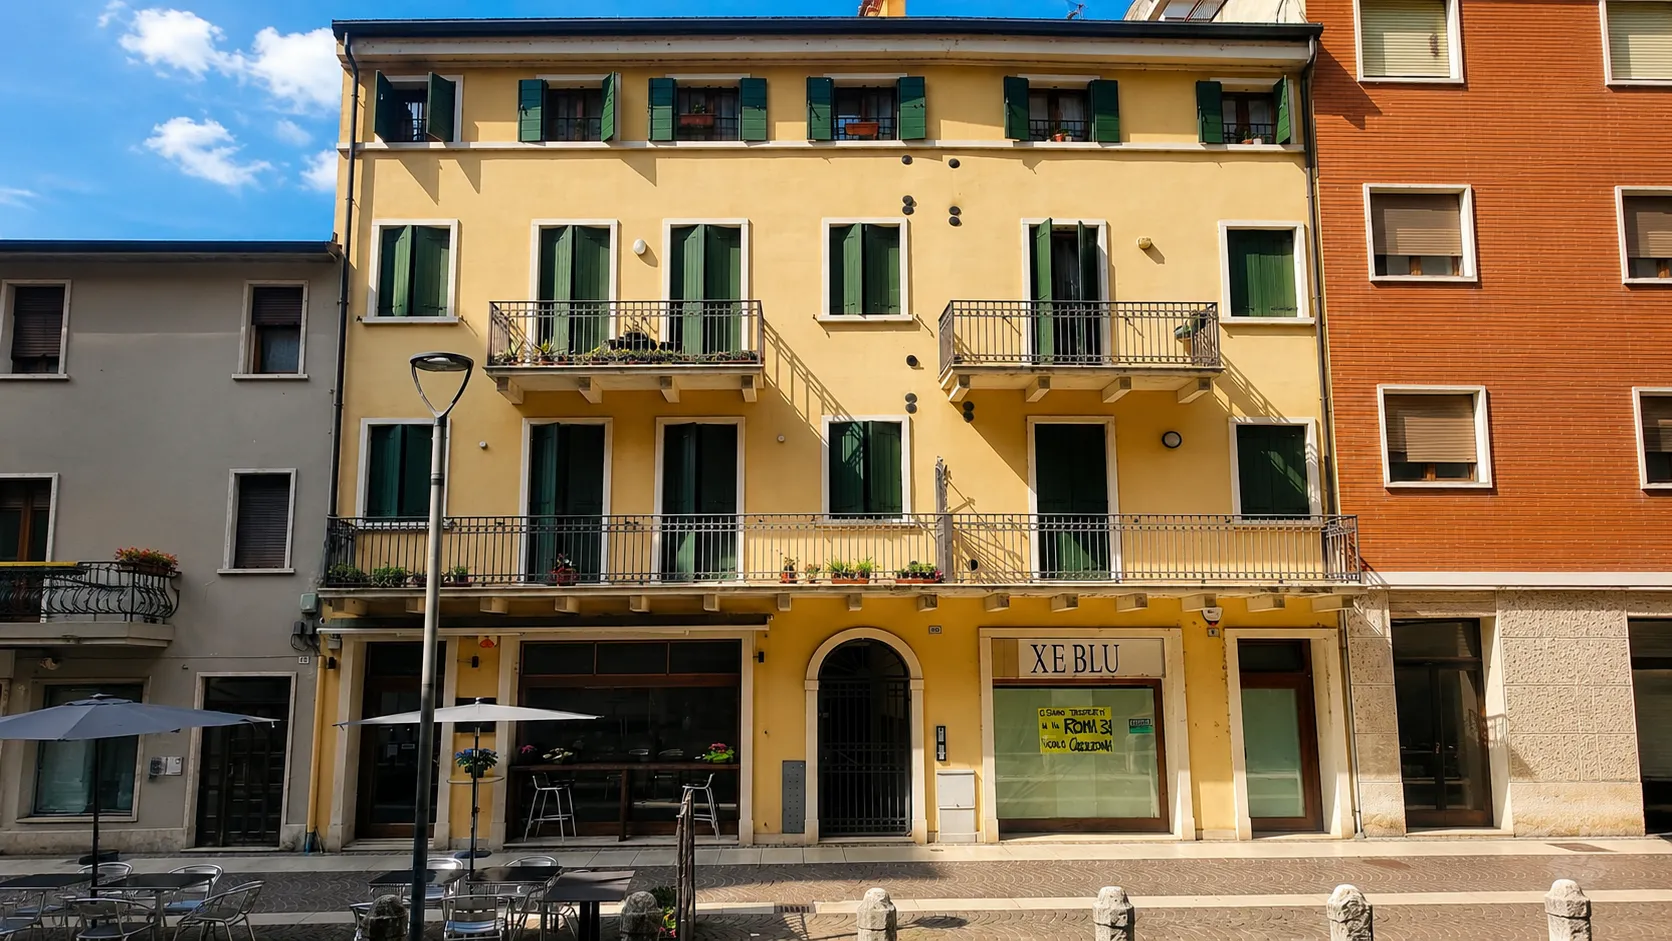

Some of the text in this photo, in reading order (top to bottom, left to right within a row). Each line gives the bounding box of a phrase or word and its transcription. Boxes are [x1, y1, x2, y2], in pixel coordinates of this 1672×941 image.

[1030, 644, 1119, 673] XE BLU
[1064, 718, 1098, 735] ROMA
